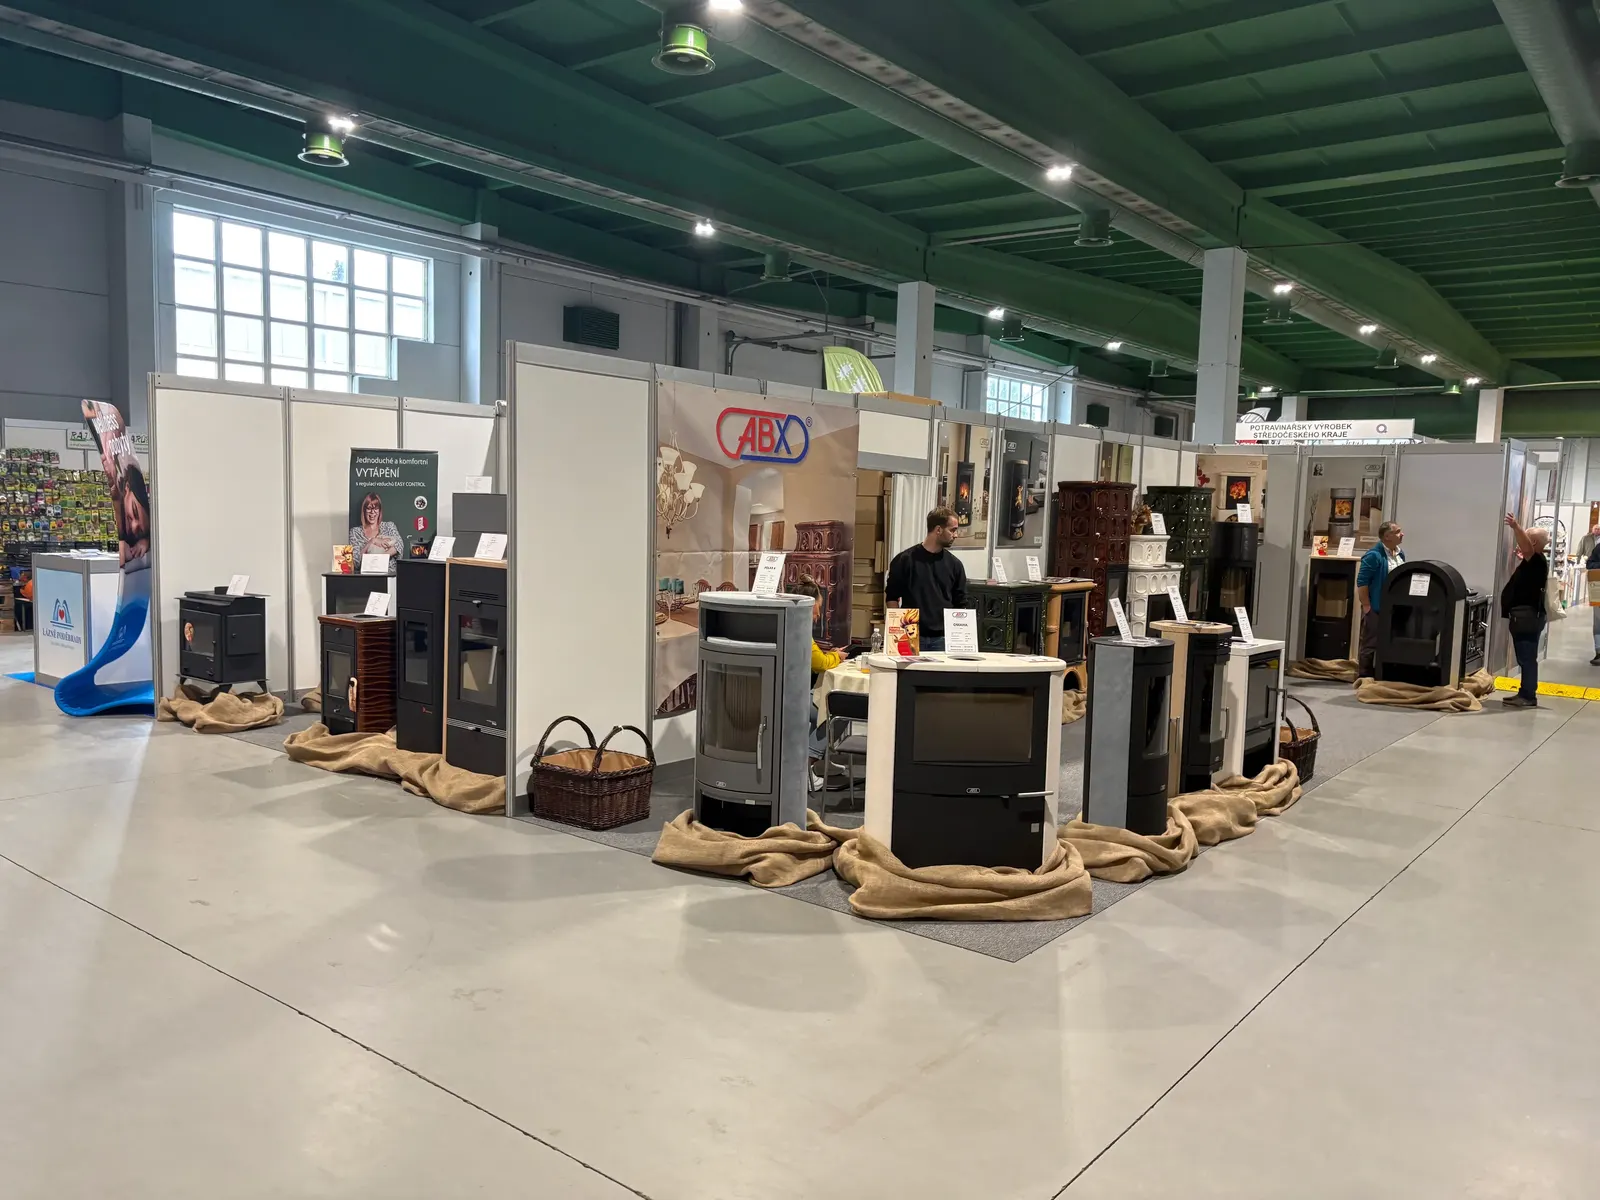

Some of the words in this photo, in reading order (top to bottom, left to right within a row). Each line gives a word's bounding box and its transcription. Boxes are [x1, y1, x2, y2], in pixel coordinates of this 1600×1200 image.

[732, 413, 794, 459] ABX
[356, 457, 393, 465] Jednoduché
[355, 467, 400, 478] VYTÁPĚNÍ
[42, 627, 56, 639] LÁZNĚ
